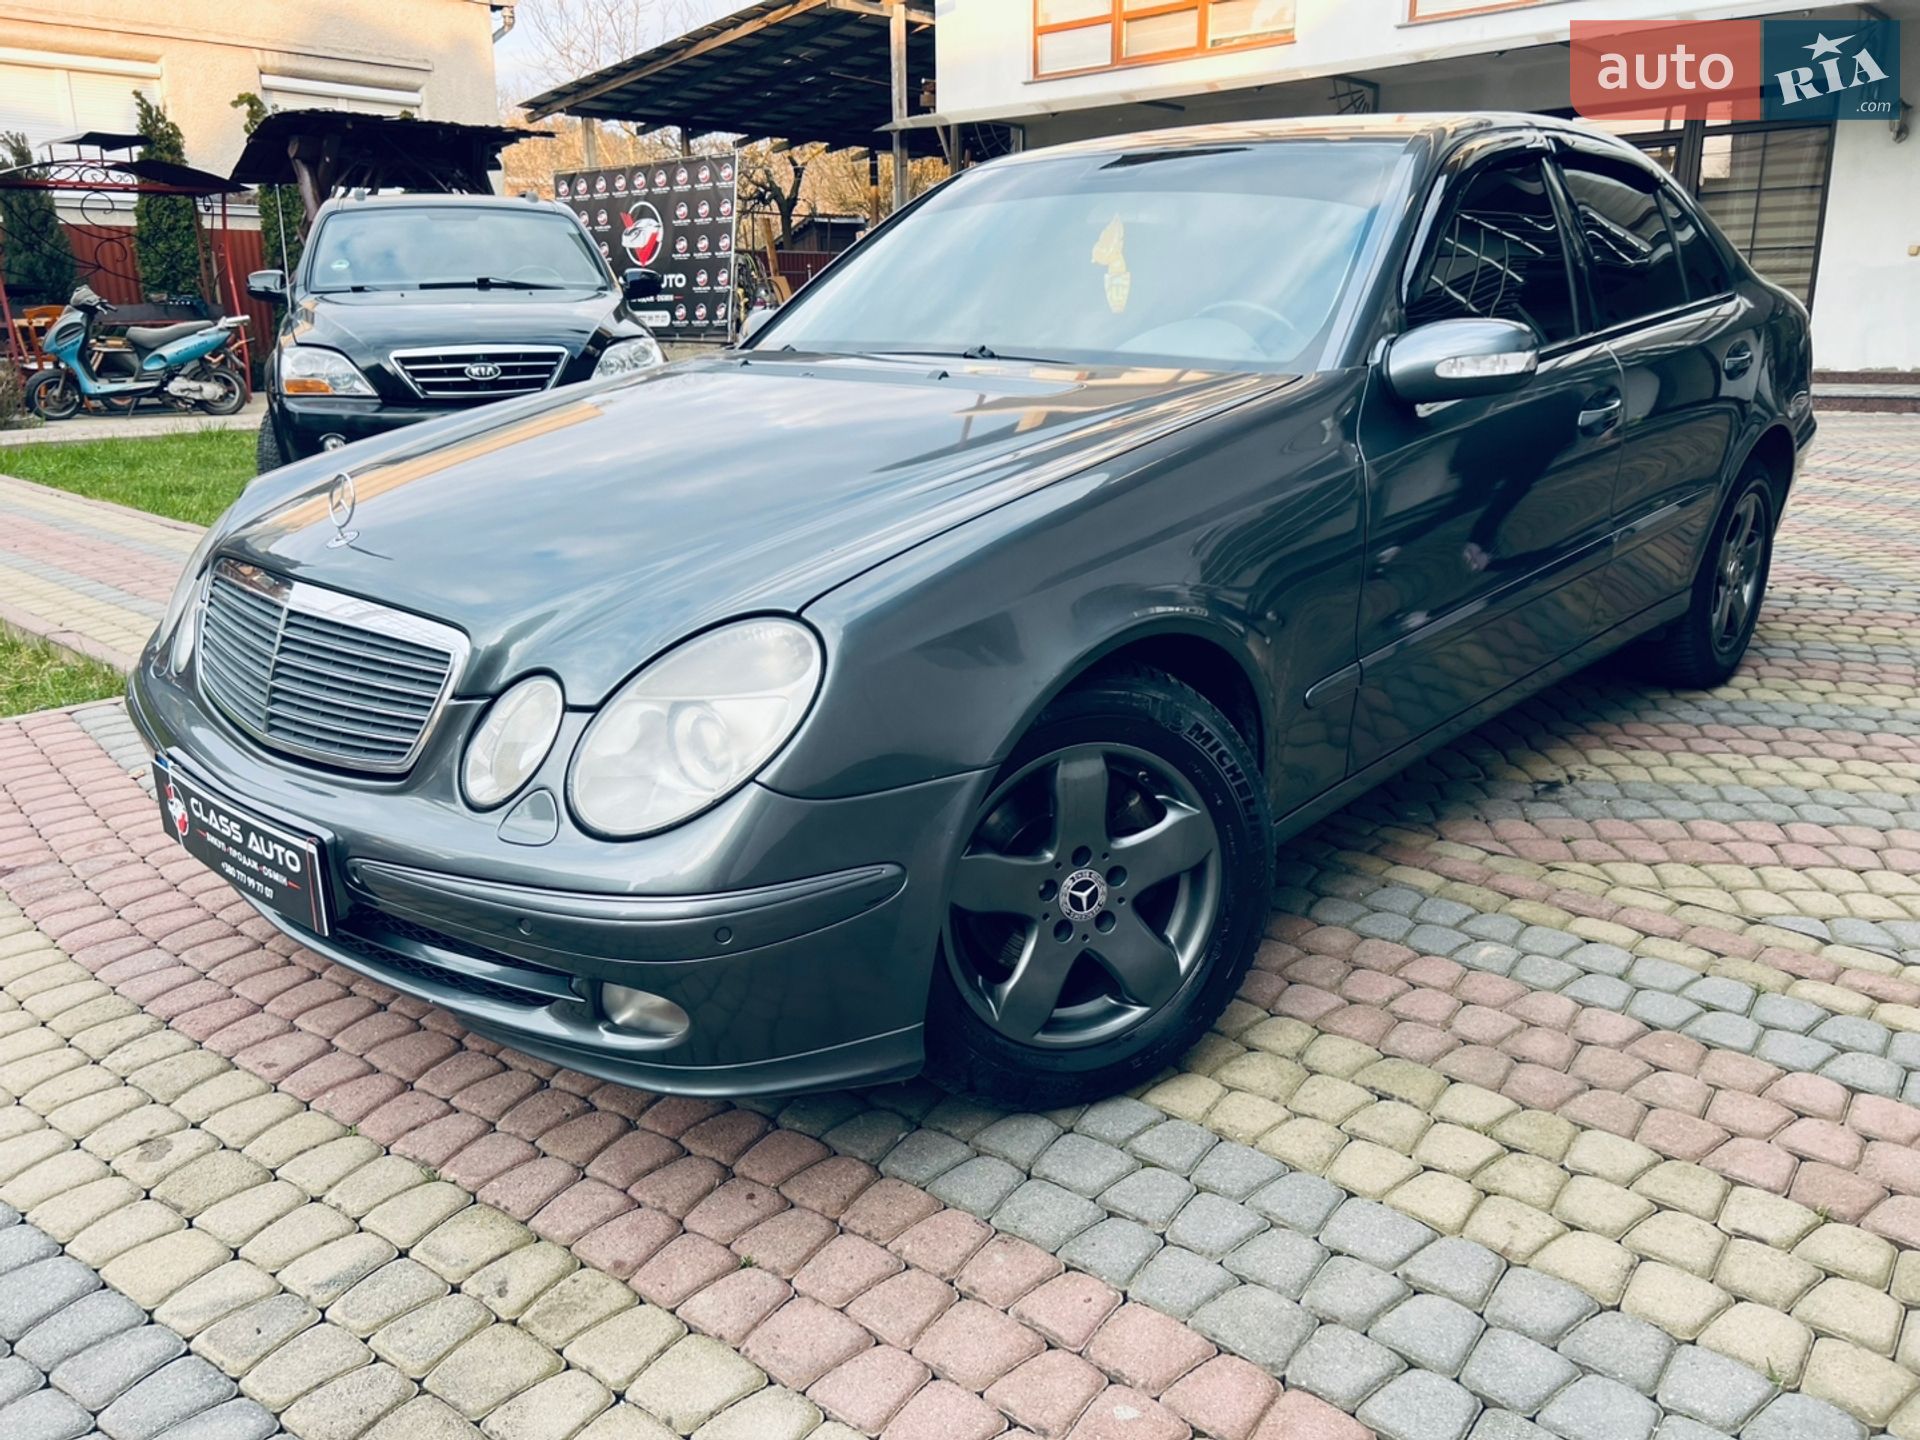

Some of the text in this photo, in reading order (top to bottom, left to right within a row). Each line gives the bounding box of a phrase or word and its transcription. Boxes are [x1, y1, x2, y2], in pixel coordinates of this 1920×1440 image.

[470, 366, 496, 376] KIA
[190, 797, 302, 873] CLASS AUTO
